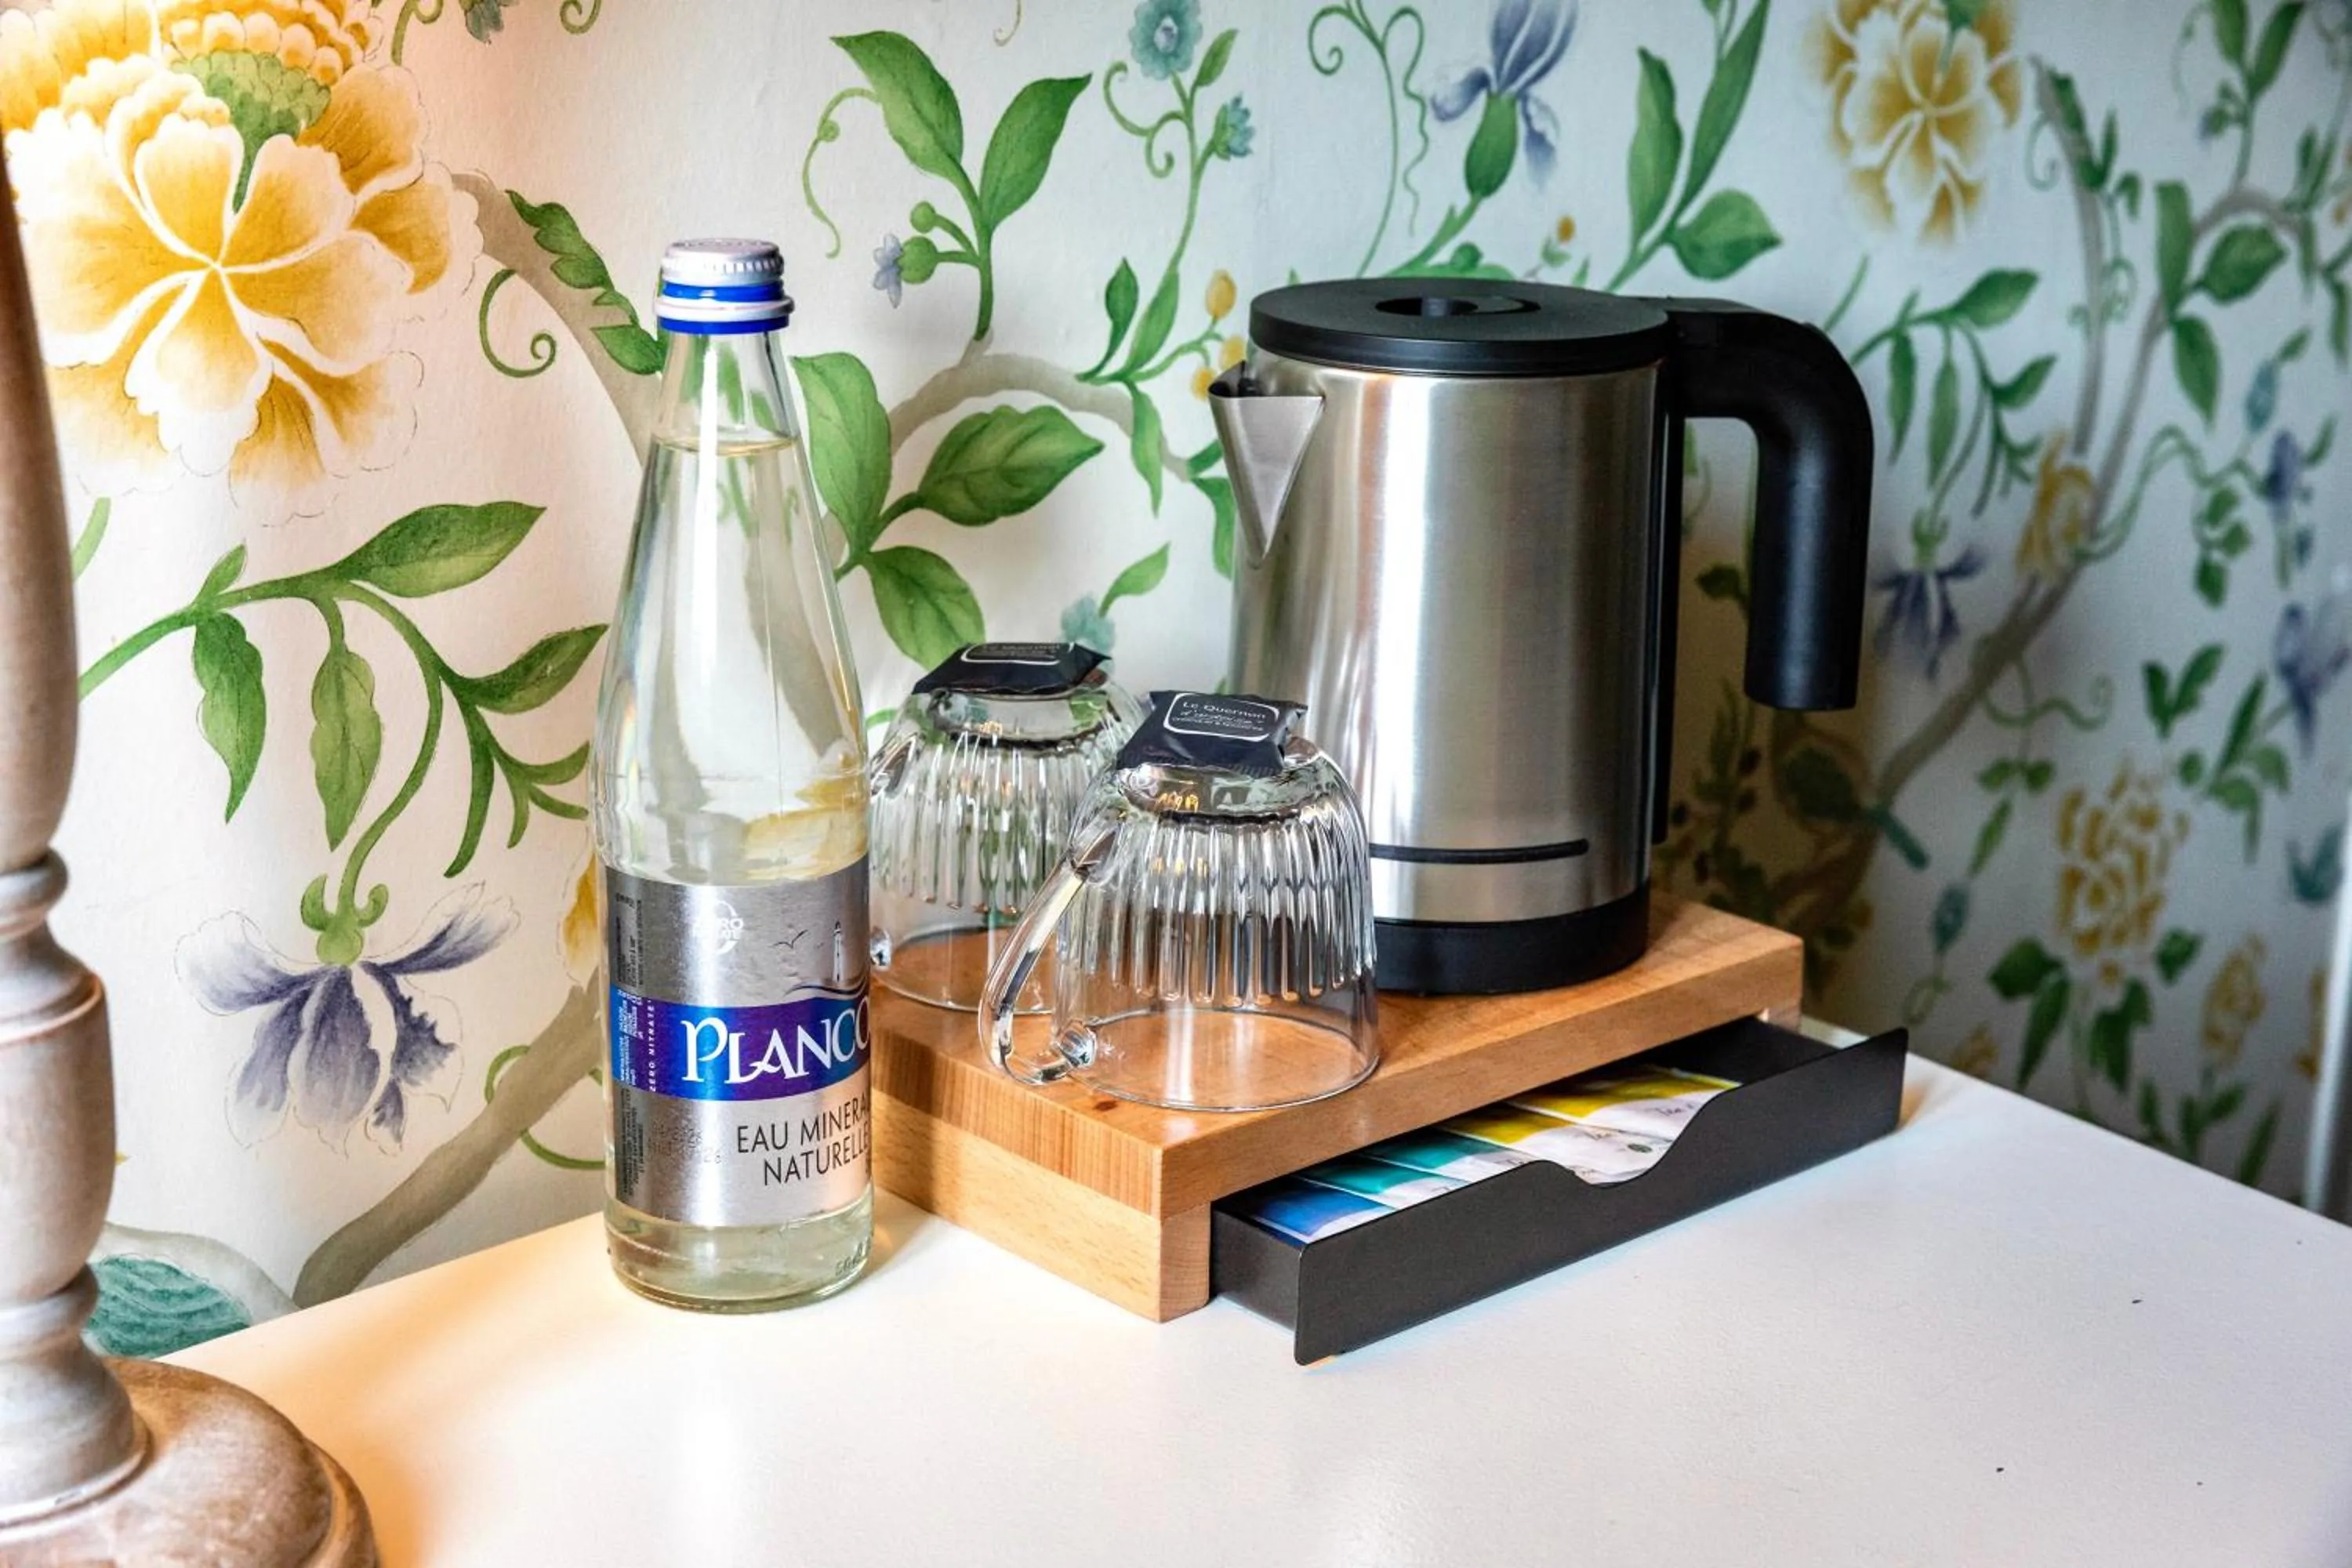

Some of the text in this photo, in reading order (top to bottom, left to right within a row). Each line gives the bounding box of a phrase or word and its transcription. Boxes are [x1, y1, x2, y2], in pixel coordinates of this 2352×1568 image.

[648, 1061, 656, 1092] ZERO
[737, 1121, 789, 1153] EAU
[800, 1091, 870, 1146] MINERA
[764, 1120, 869, 1186] NATURELLE
